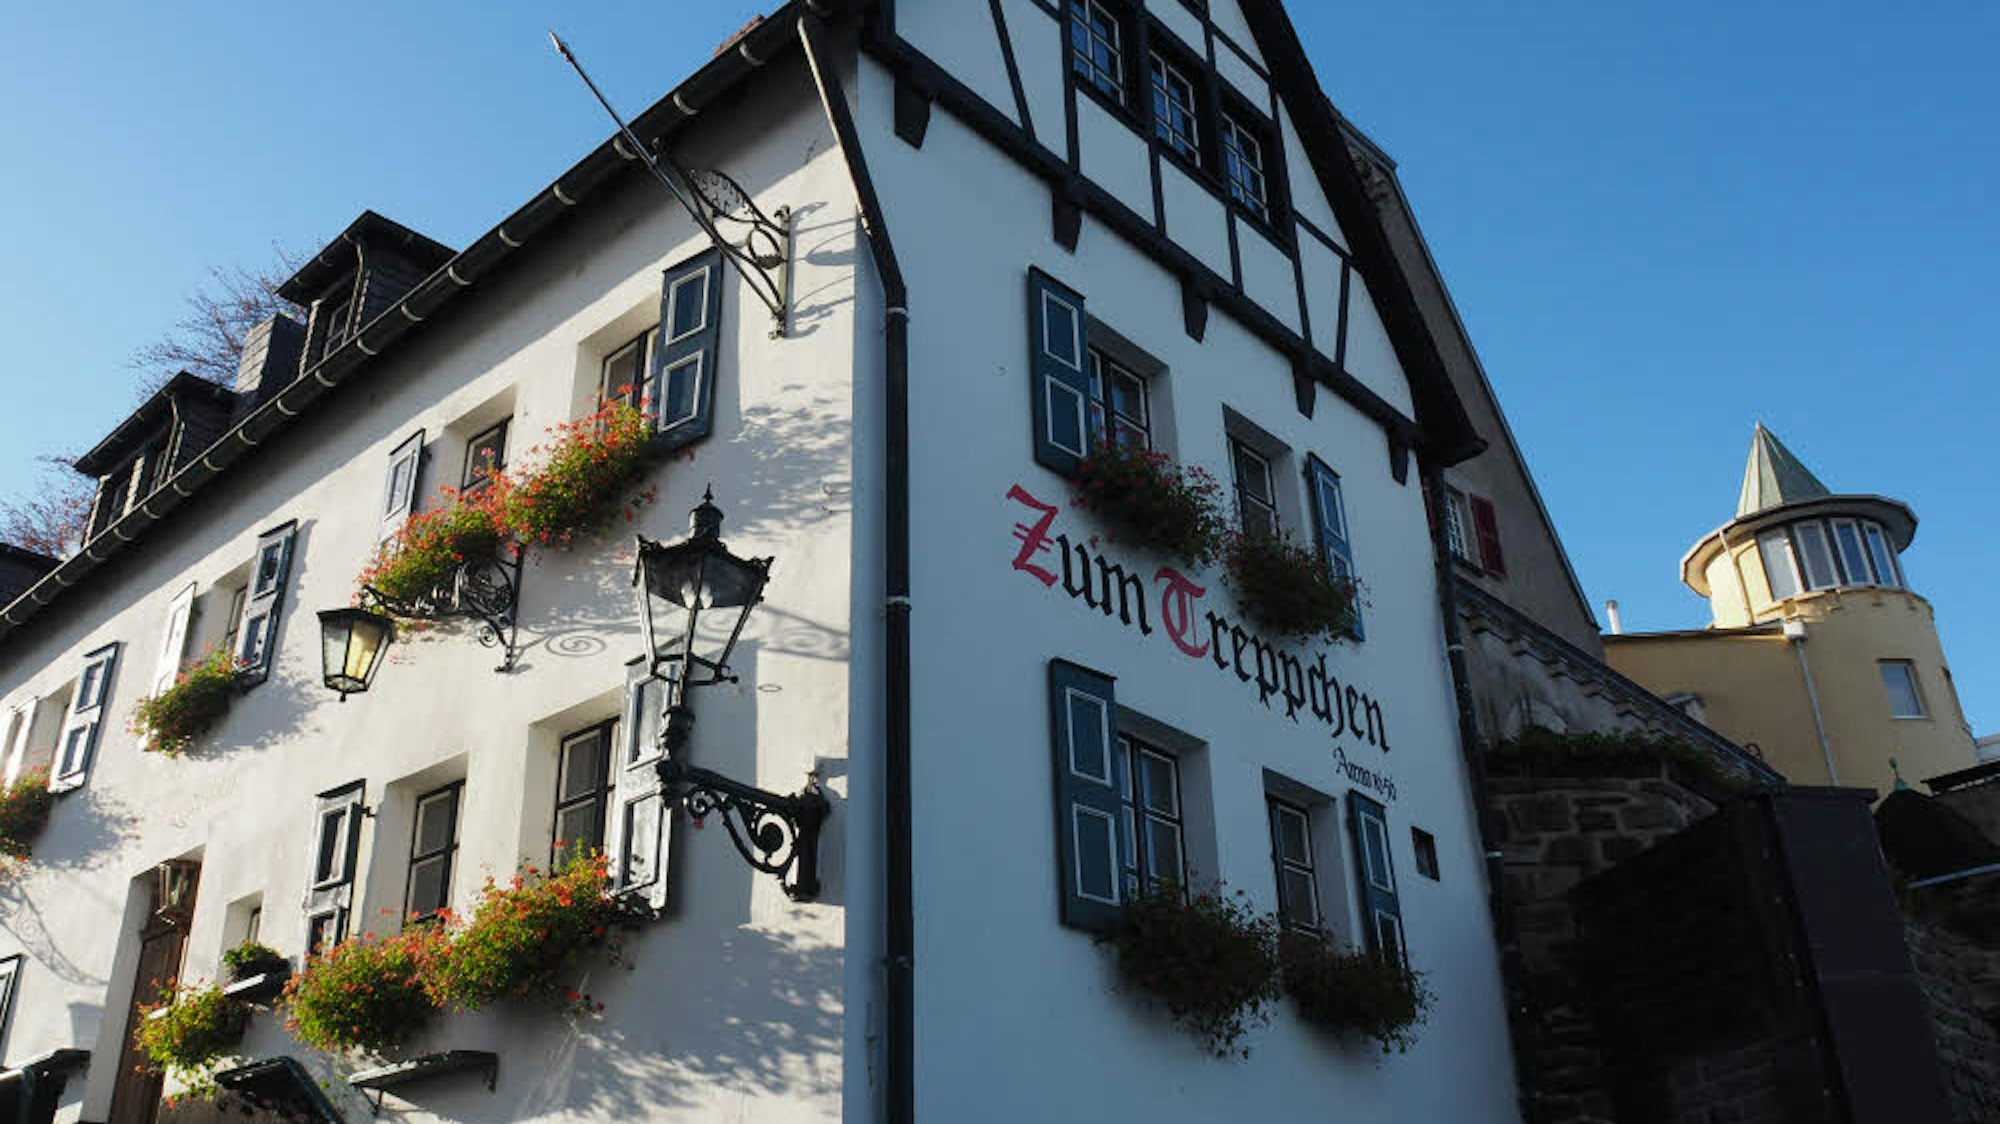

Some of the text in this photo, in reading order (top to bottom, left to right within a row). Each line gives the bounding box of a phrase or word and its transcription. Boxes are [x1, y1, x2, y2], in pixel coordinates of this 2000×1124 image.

[1006, 483, 1390, 753] Zum Treppchen
[1333, 745, 1372, 789] Anno
